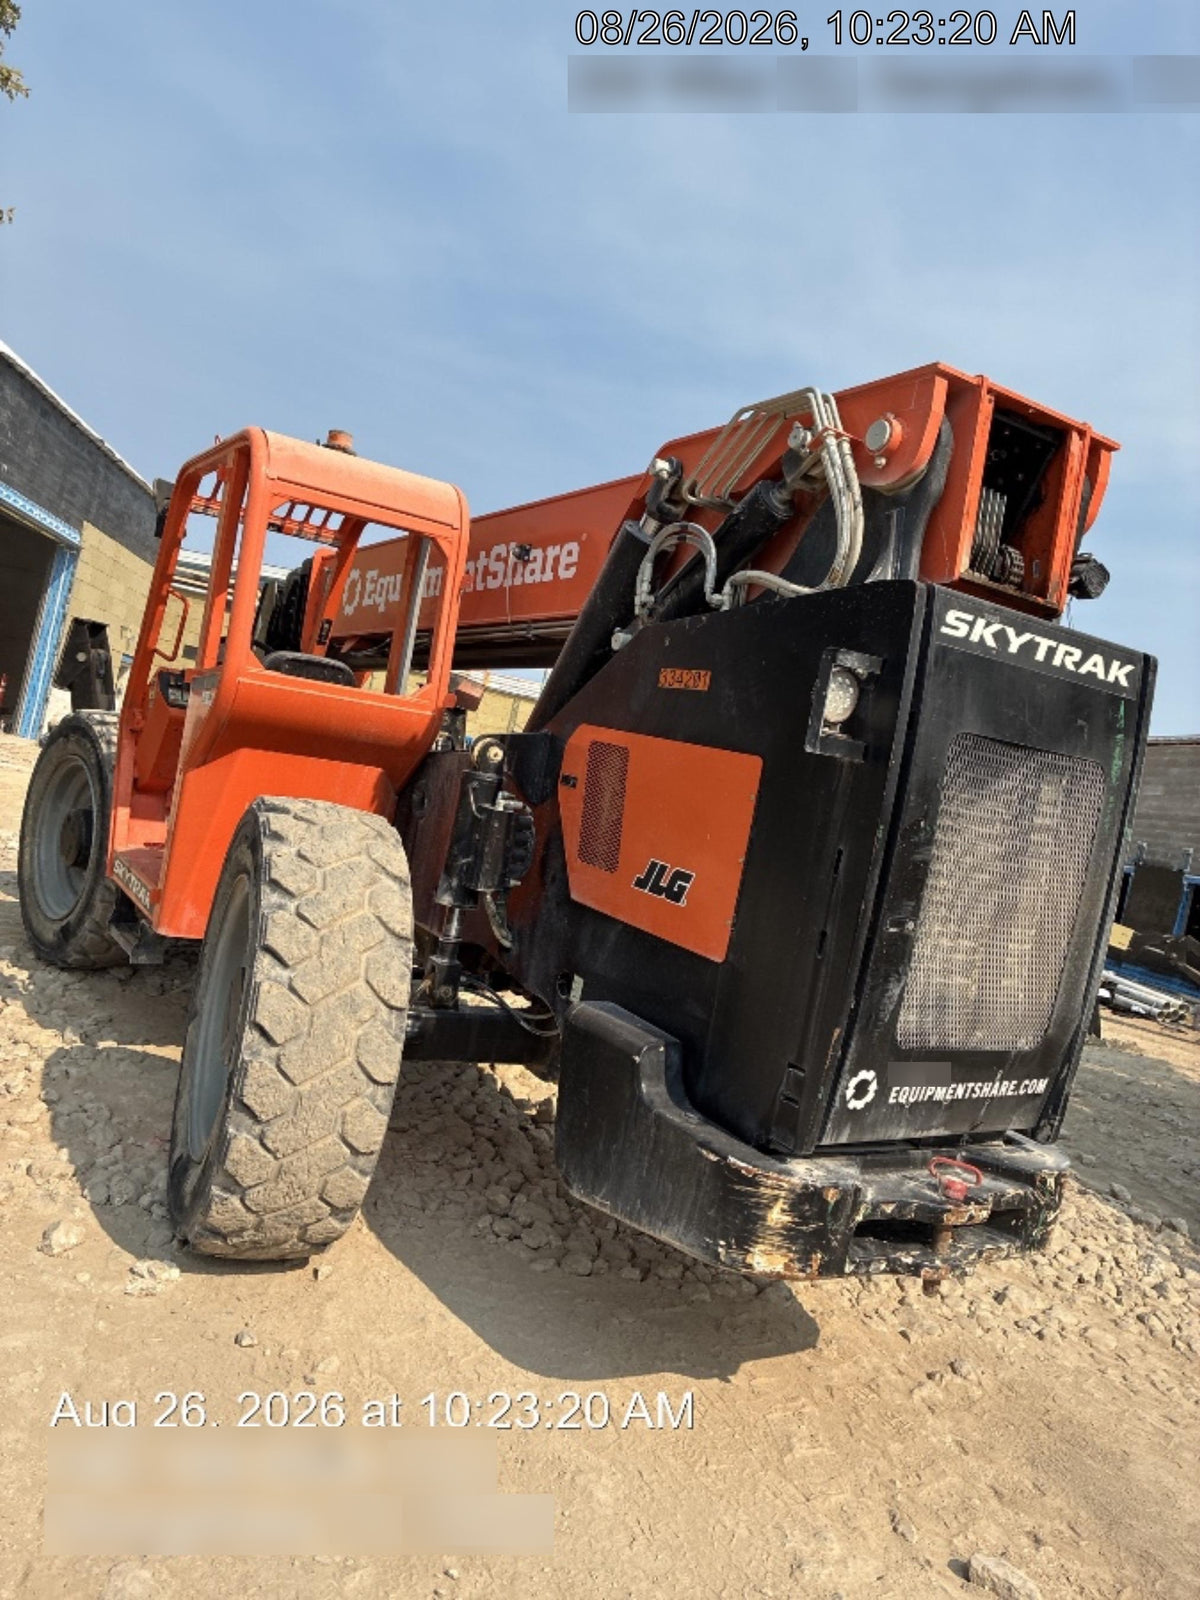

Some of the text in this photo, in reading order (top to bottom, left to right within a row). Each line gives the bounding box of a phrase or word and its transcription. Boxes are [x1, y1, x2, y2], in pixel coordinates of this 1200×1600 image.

[940, 608, 1135, 688] SKYTRAK
[631, 858, 695, 906] JLG
[888, 1077, 1049, 1104] EQUIPMENTSHARE.COM
